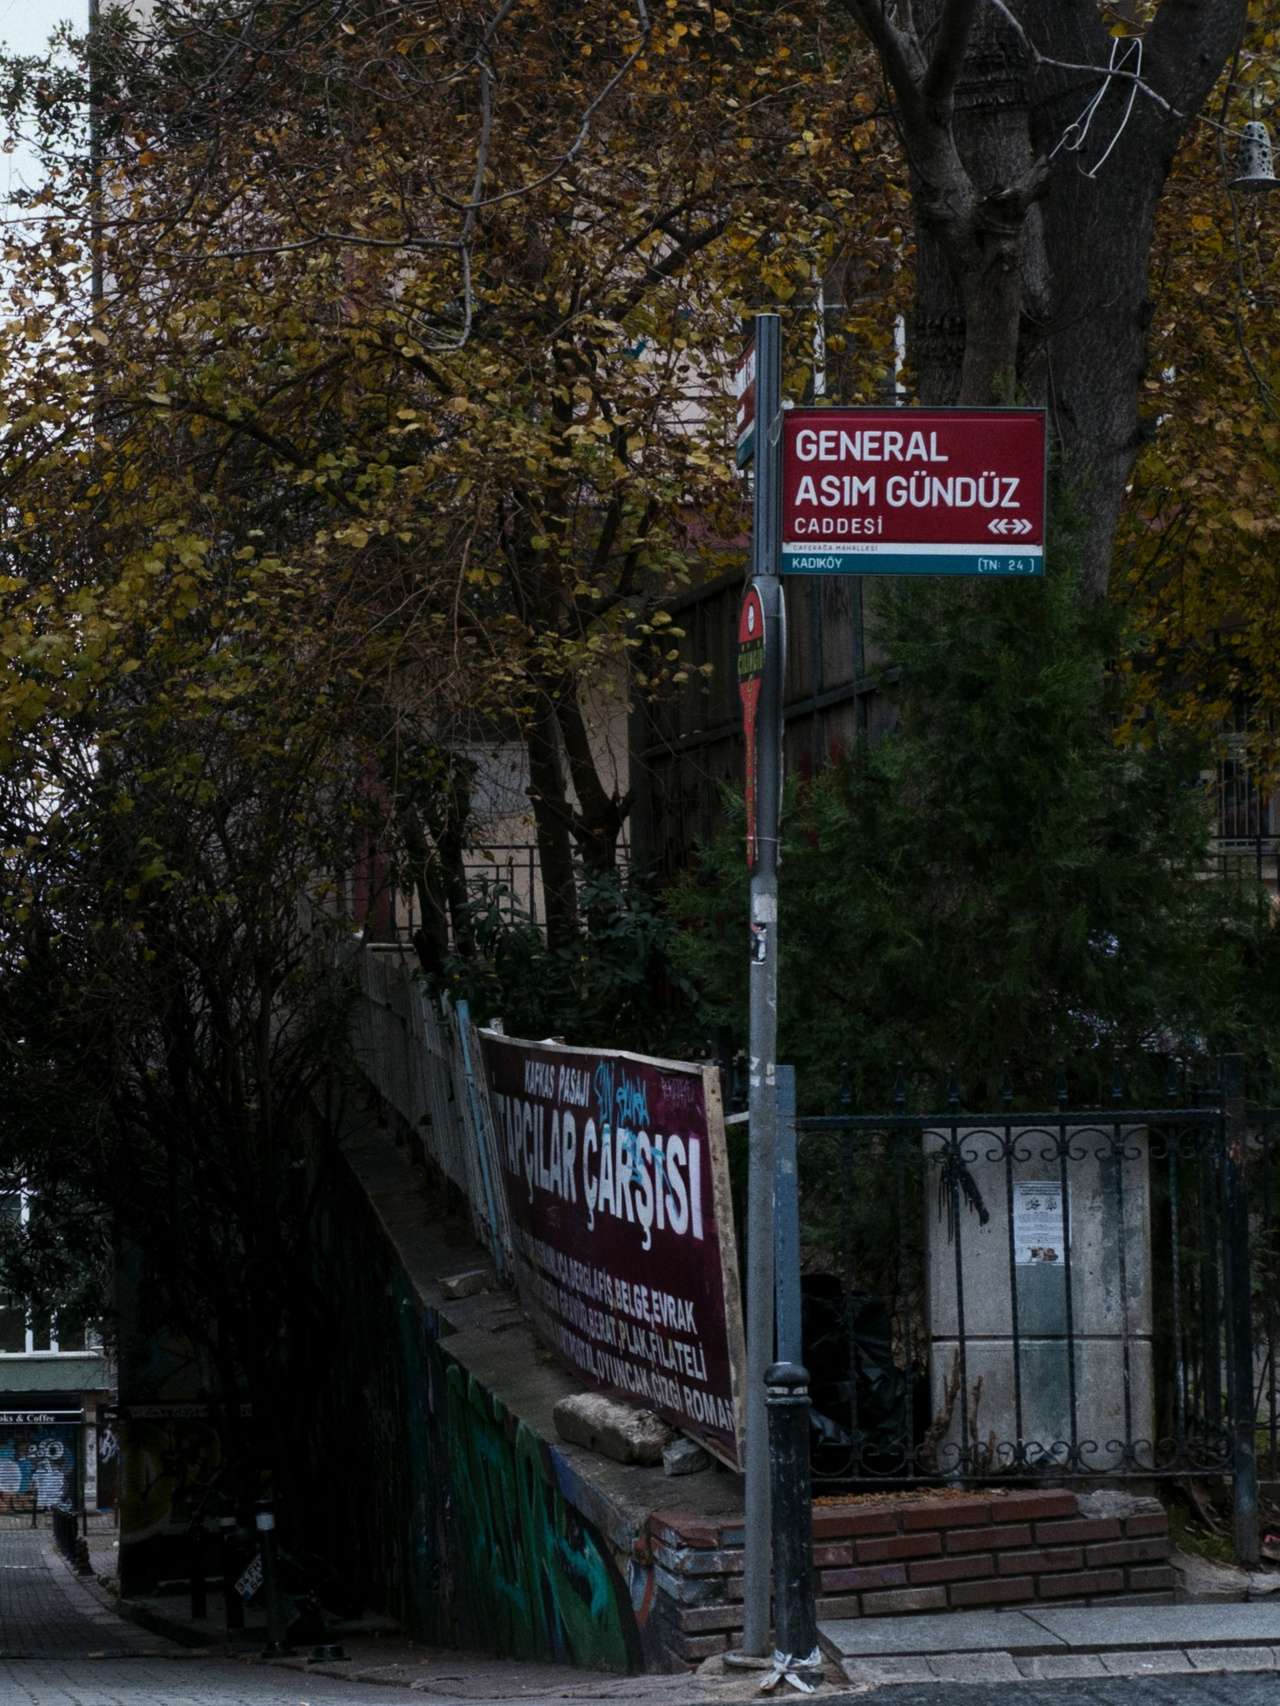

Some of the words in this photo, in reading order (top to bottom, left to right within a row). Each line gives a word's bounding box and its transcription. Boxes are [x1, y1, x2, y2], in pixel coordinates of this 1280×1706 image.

[795, 429, 949, 462] GENERAL
[794, 475, 876, 506] ASIM
[886, 470, 1021, 508] GÜNDÜZ
[794, 515, 883, 534] CADDESİ
[793, 543, 833, 551] CAFERAĞA
[792, 557, 843, 569] KADIKÖY
[1008, 560, 1024, 571] 24
[524, 1060, 555, 1099] KAFKAS
[559, 1064, 590, 1107] PASAJI
[583, 1116, 704, 1251] ÇARŞISI
[15, 1414, 23, 1422] &
[26, 1413, 55, 1422] Coffee
